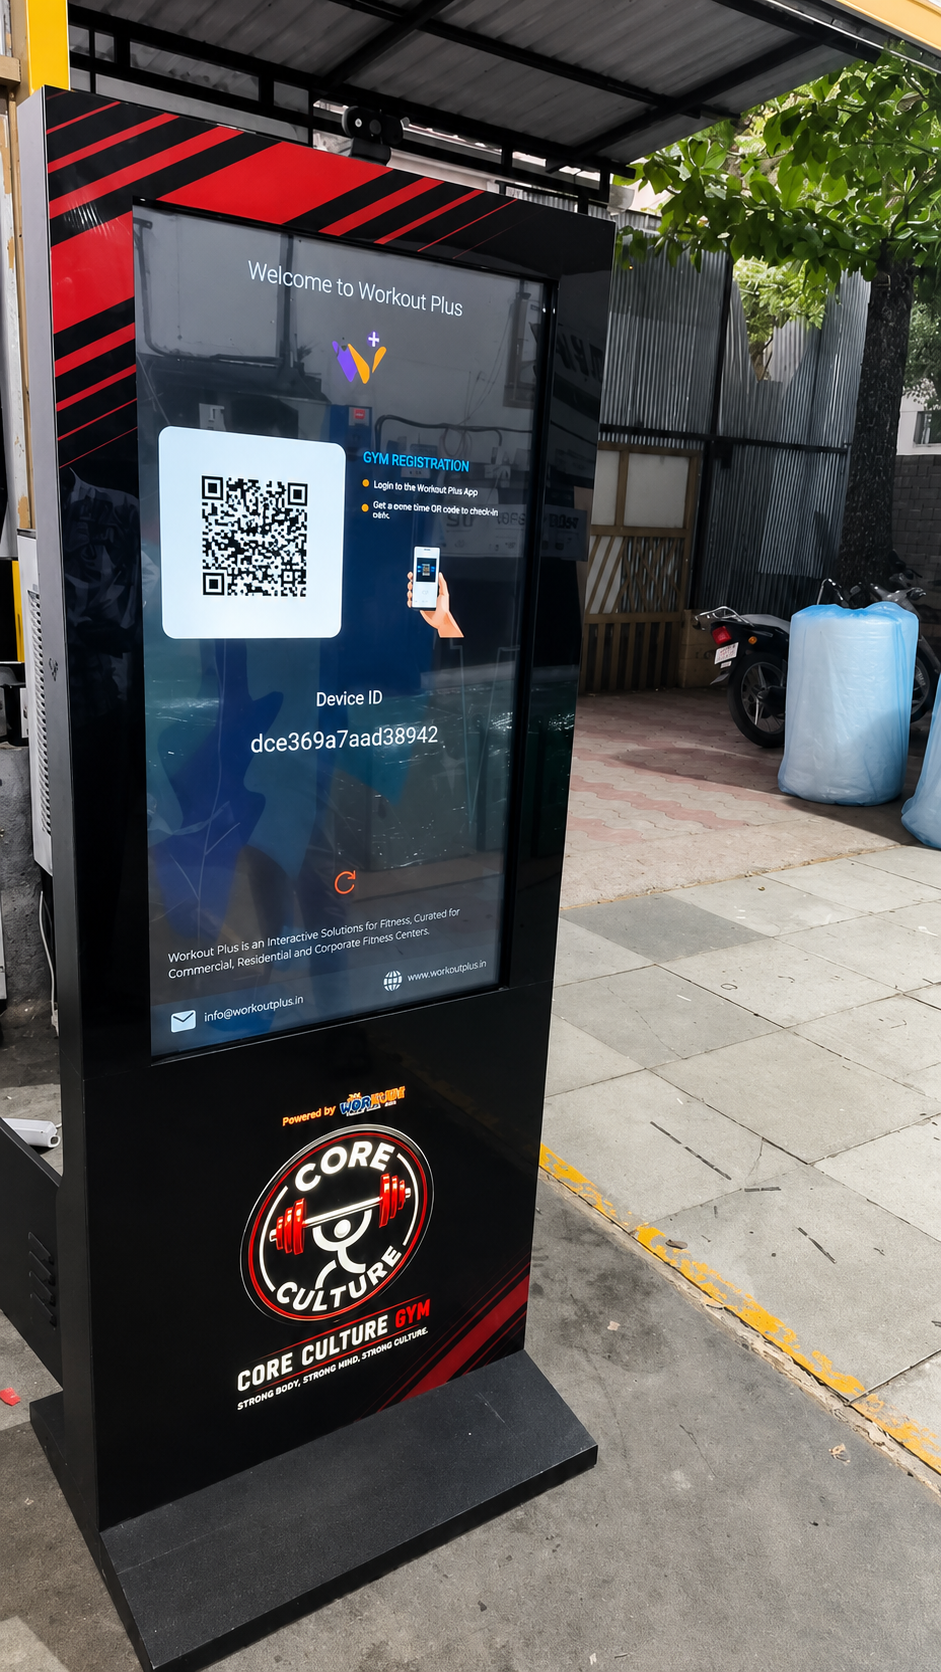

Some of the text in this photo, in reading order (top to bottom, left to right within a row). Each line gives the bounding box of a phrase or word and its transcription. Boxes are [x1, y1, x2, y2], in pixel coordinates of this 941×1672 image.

[248, 260, 463, 317] Welcome to Workout Plus
[363, 451, 470, 472] GYM REGISTRATION
[373, 480, 479, 498] Login to the Workout Plus App
[373, 501, 386, 510] Get
[413, 503, 430, 512] time
[443, 505, 460, 514] code
[461, 507, 469, 515] to
[316, 689, 383, 707] Device ID
[250, 725, 438, 754] dce369a7aad38942
[167, 907, 461, 963] Workout Plus is an Interactive Solutions for Fitness, Curated for
[168, 927, 430, 980] Commercial, Residential and Corporate Fitness Centers.
[407, 959, 487, 982] www.workoutplus.in
[204, 995, 304, 1023] info@workoutplus.in
[282, 1108, 322, 1127] Powered
[324, 1105, 337, 1117] by
[294, 1140, 396, 1193] CORE
[275, 1245, 402, 1313] CULTURE
[237, 1298, 431, 1392] CORE CULTURE GYM
[237, 1389, 274, 1411] STRONG
[275, 1379, 301, 1397] BODY,
[303, 1364, 337, 1385] STRONG
[361, 1341, 393, 1360] STRONG
[394, 1326, 429, 1347] CULTURE.
